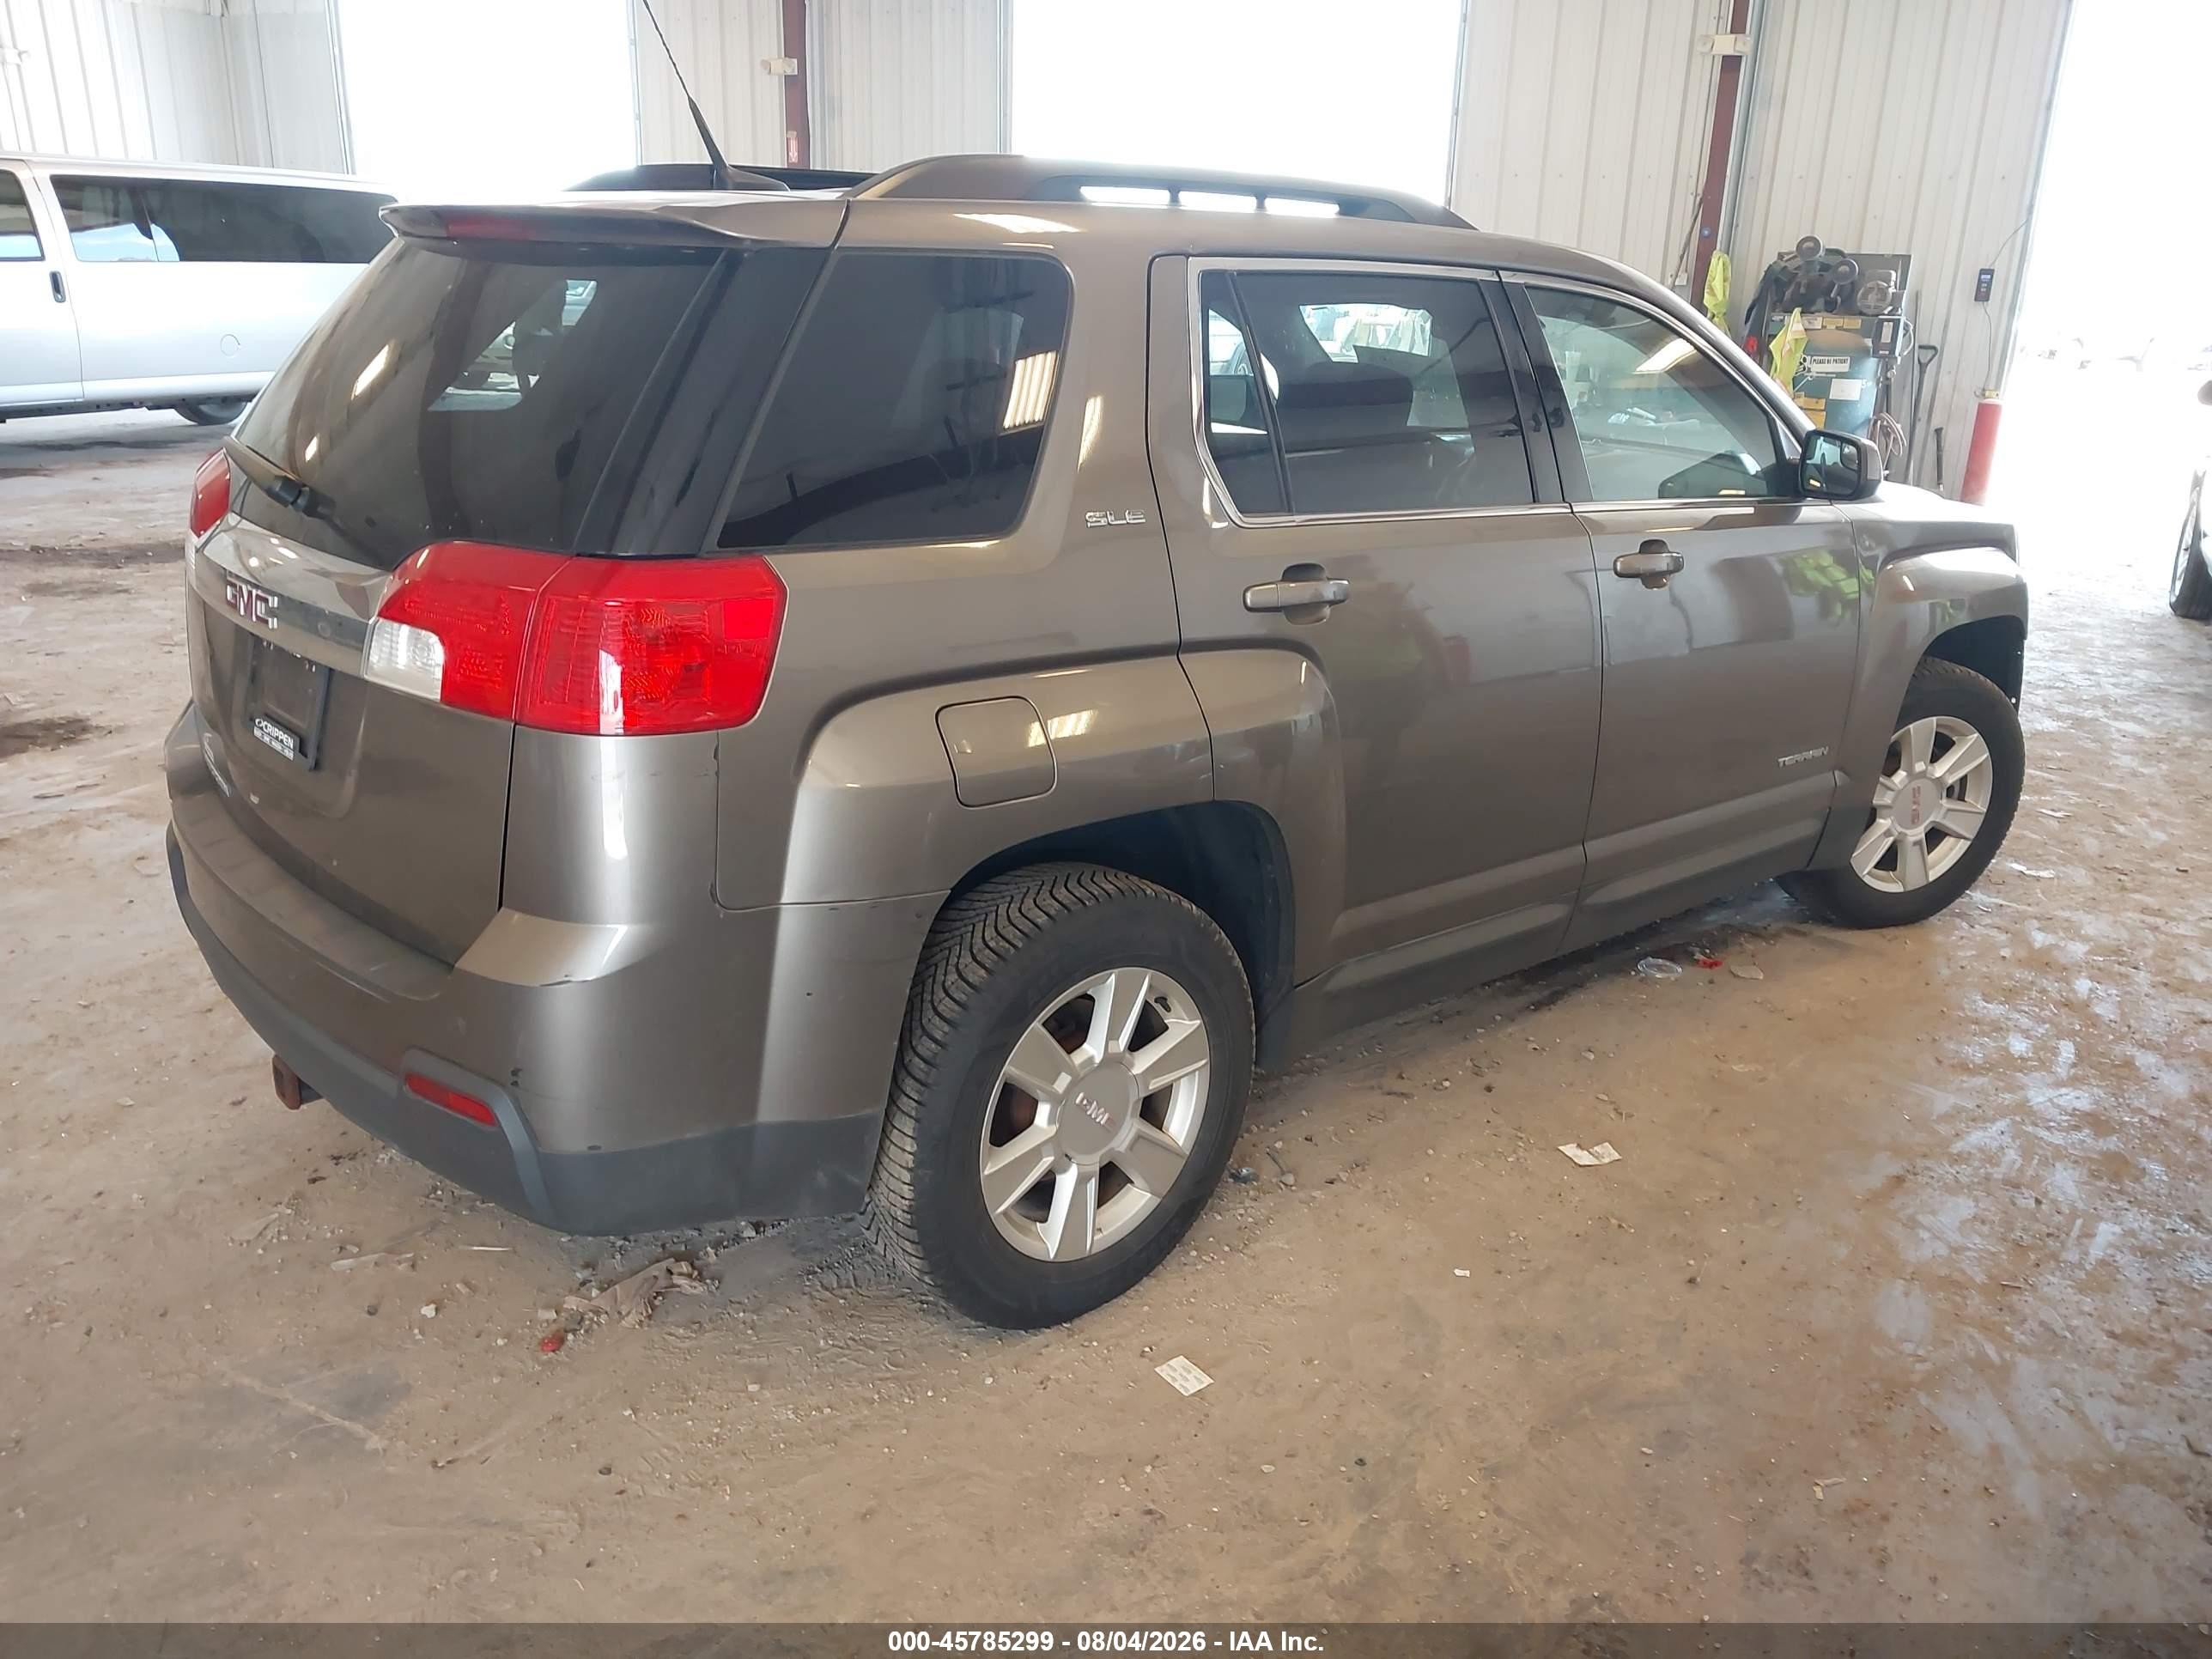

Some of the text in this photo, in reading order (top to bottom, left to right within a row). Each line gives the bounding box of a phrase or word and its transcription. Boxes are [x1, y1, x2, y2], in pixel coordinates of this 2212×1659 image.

[1085, 509, 1146, 528] SLE
[226, 579, 278, 630] GMC
[263, 720, 294, 750] CRIPPEN
